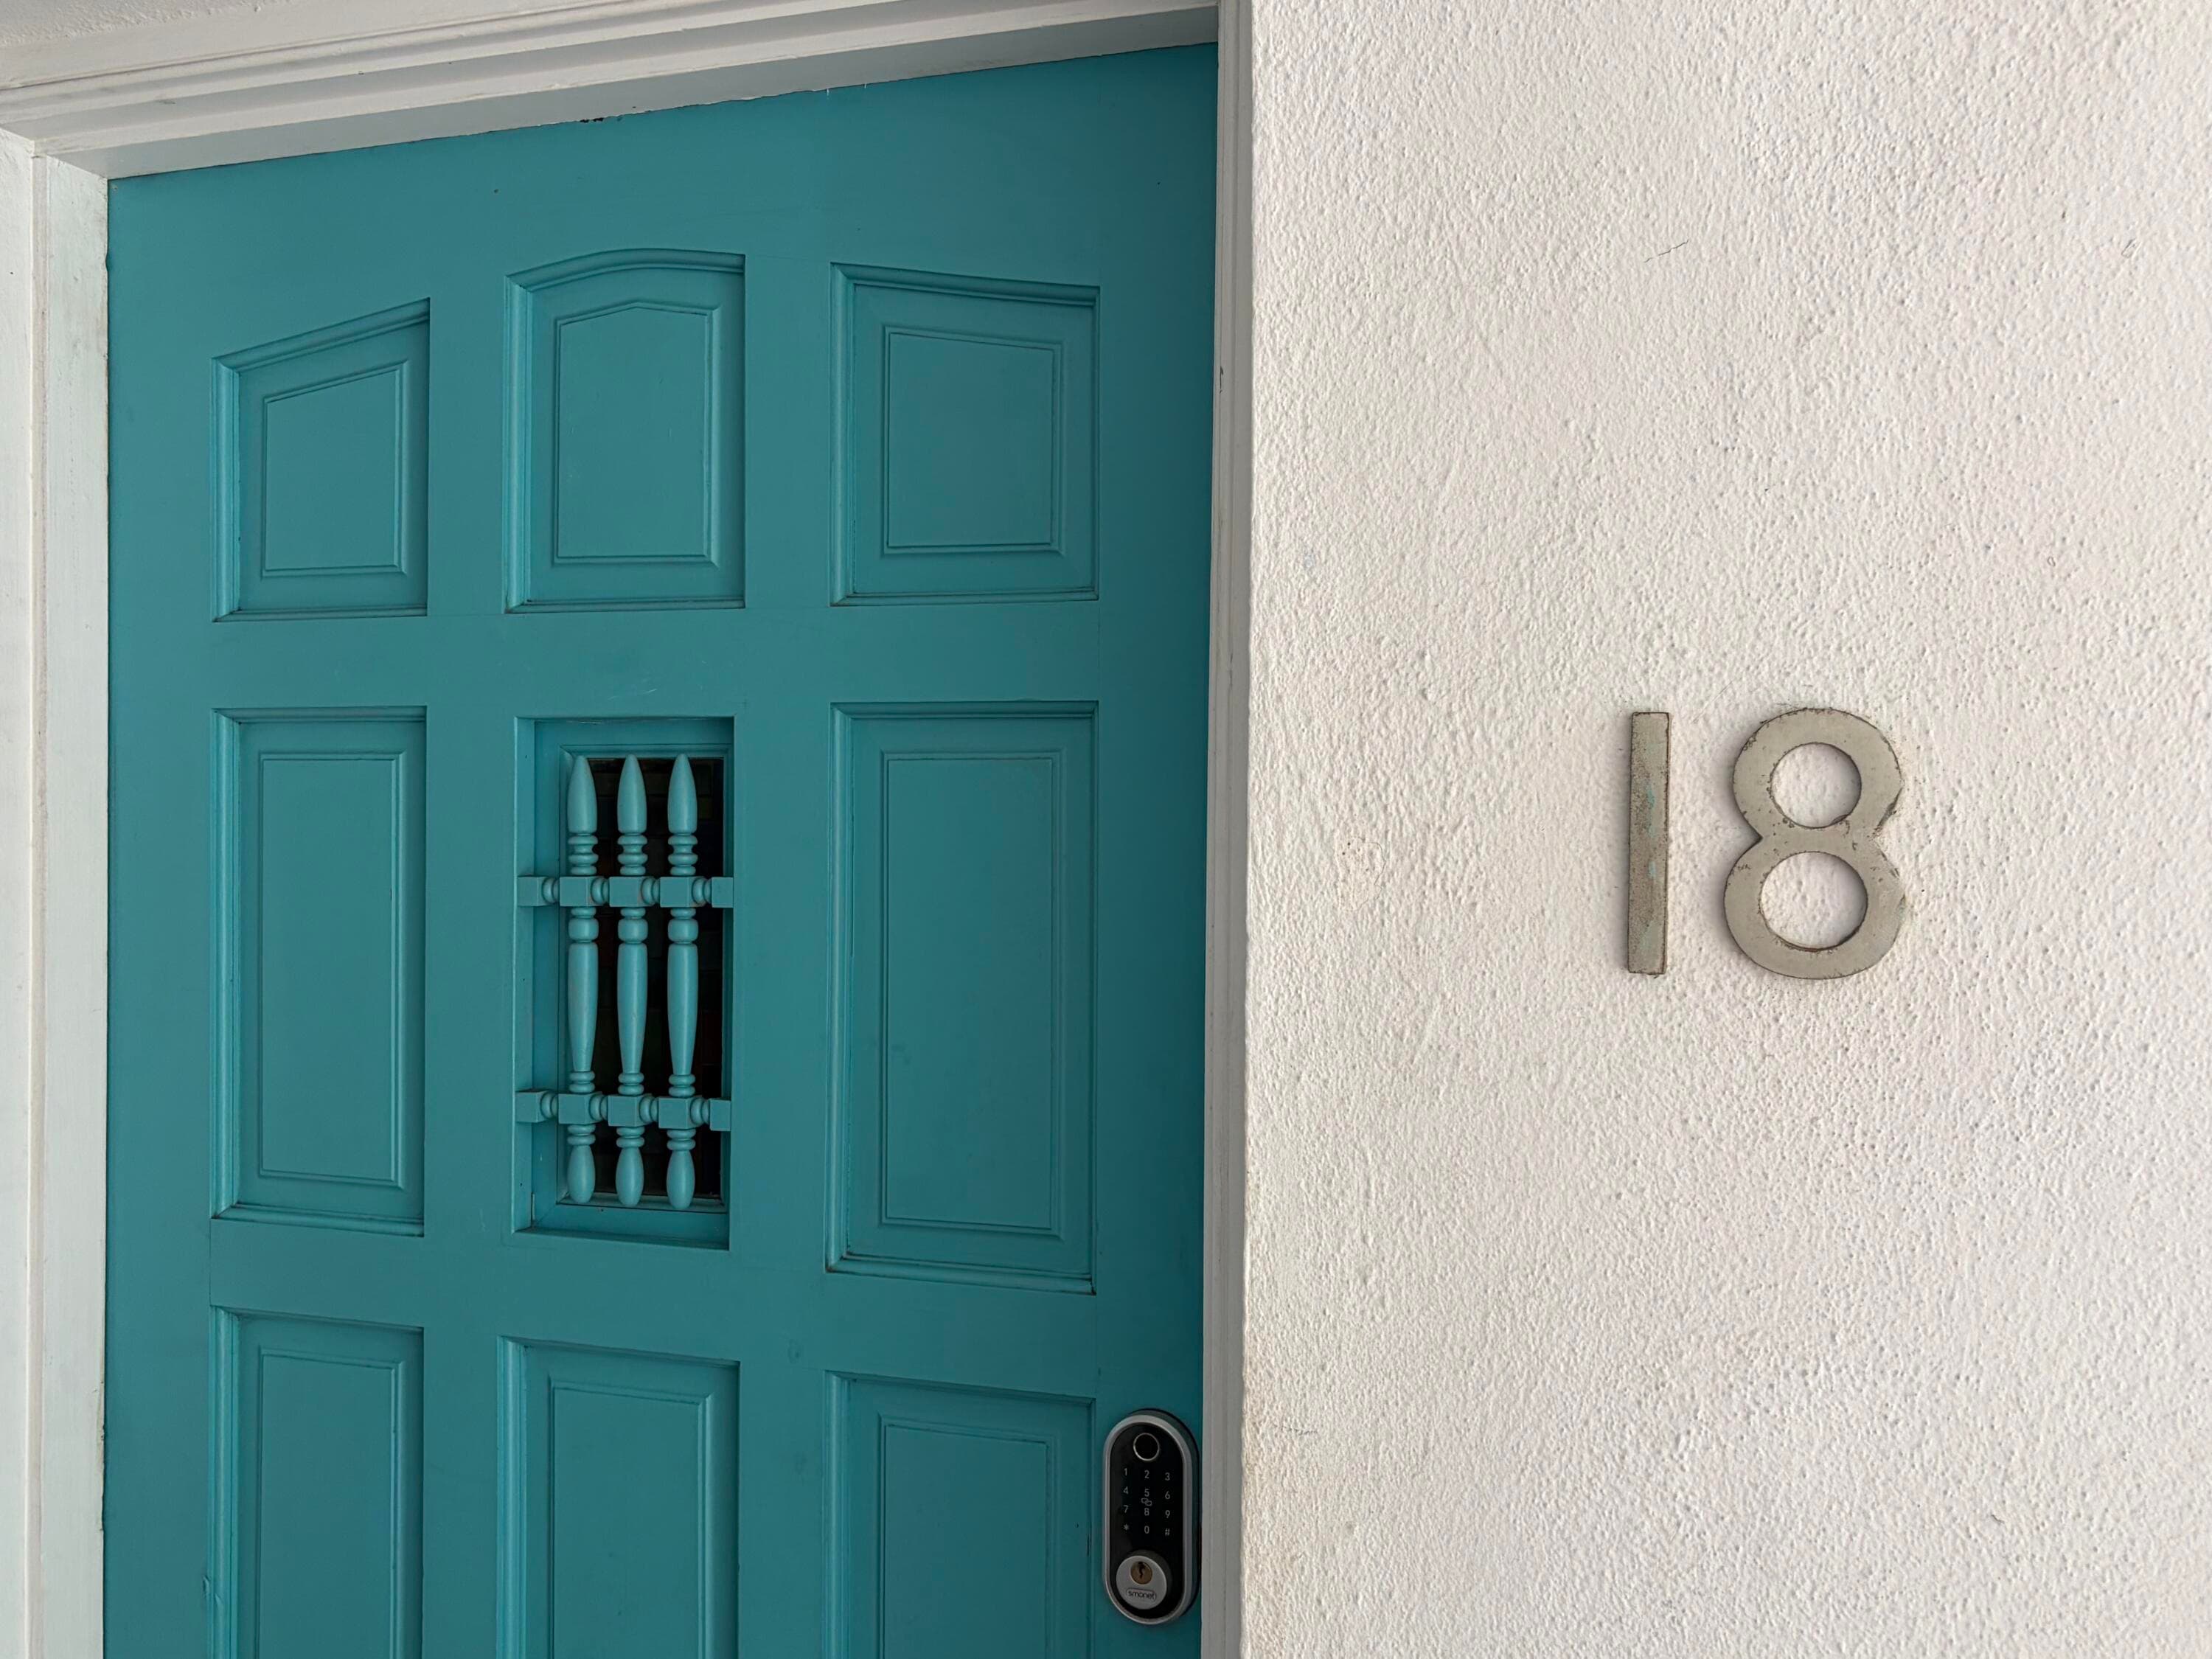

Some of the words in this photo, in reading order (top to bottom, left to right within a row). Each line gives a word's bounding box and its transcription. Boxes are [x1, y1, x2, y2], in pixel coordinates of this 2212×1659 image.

[1627, 708, 1905, 980] 18
[1144, 1470, 1150, 1479] 2
[1165, 1472, 1170, 1481] 3
[1123, 1486, 1129, 1495] 4
[1144, 1488, 1150, 1497] 5
[1165, 1491, 1170, 1500] 6
[1123, 1504, 1129, 1513] 7
[1144, 1507, 1150, 1516] 8
[1165, 1509, 1170, 1518] 9
[1144, 1526, 1150, 1534] 0
